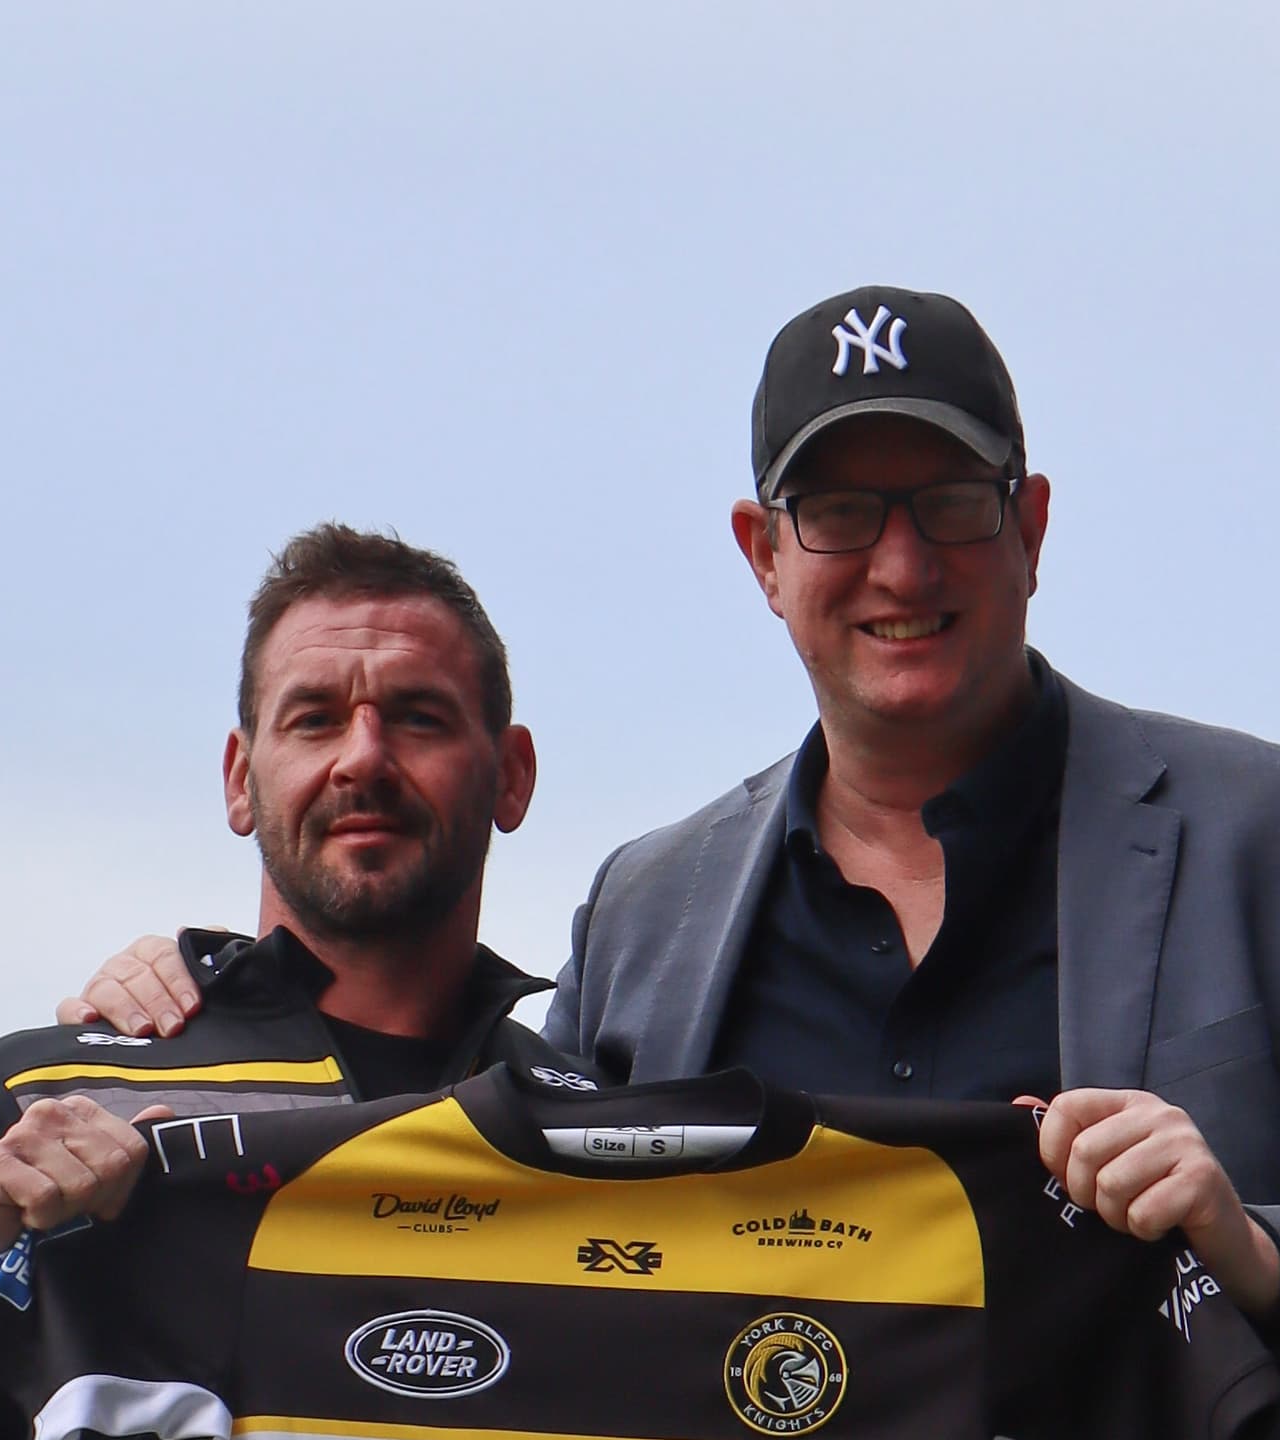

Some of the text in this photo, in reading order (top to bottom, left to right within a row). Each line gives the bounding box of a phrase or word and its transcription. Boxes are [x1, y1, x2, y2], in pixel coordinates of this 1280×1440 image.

[592, 1138, 666, 1155] Size S
[371, 1193, 501, 1222] David Lloyd
[413, 1224, 453, 1233] CLUBS
[732, 1218, 872, 1242] COLD BATH
[758, 1238, 823, 1247] BREWING
[381, 1328, 456, 1353] LAND
[741, 1319, 833, 1350] YORK RLFC
[386, 1353, 477, 1377] ROVER
[730, 1367, 742, 1377] 18
[744, 1404, 825, 1430] KNIGHTS
